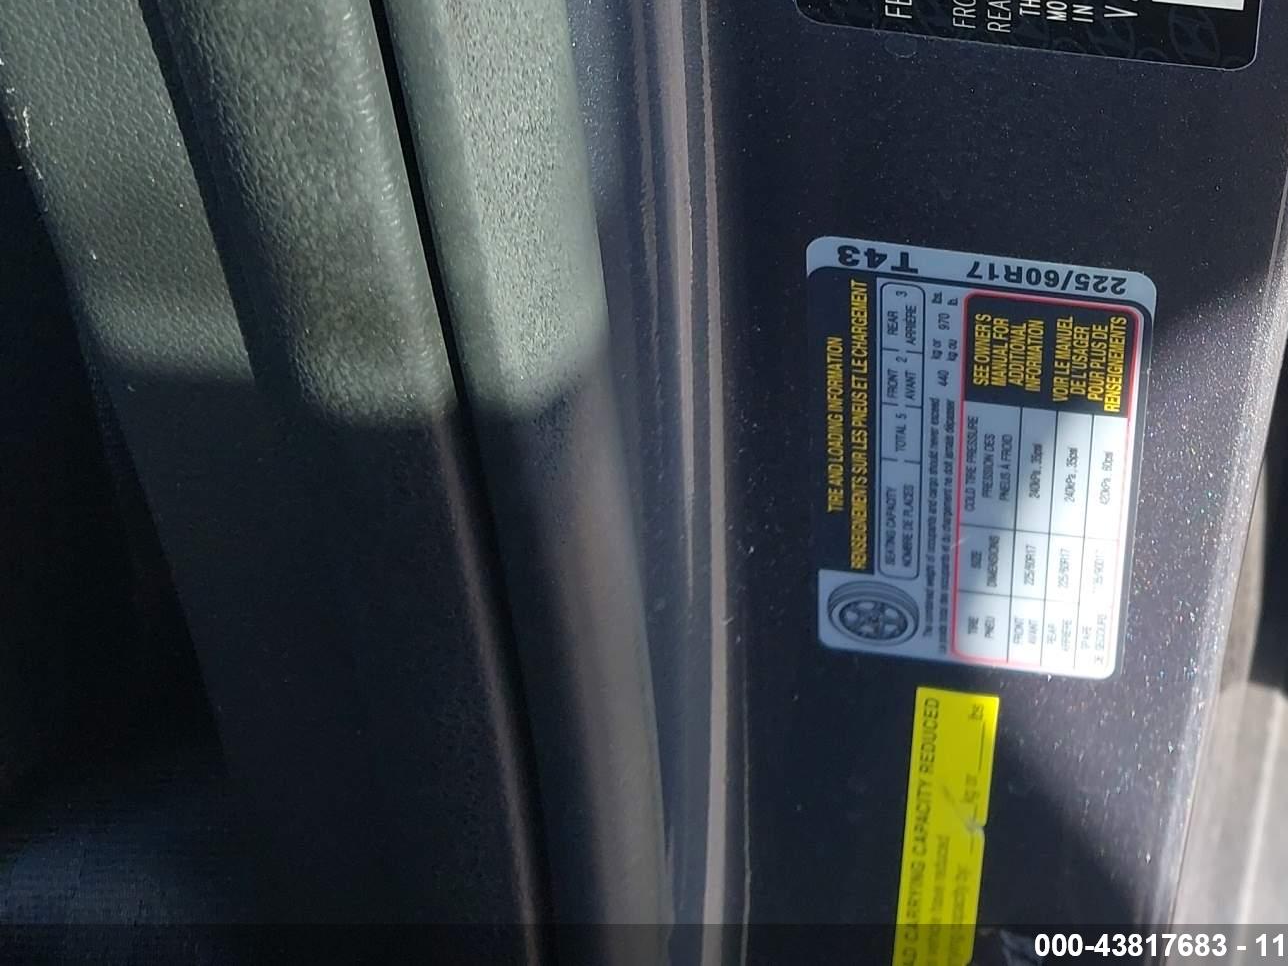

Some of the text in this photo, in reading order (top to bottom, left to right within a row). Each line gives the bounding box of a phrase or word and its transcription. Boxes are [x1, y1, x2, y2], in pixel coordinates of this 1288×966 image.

[1071, 3, 1093, 22] IN
[894, 288, 908, 298] 3
[966, 258, 1128, 299] 225/60R17
[849, 278, 869, 358] CHARGEMENT
[886, 309, 899, 336] REAR
[937, 311, 951, 331] 970
[850, 357, 868, 374] LE
[894, 354, 908, 363] 2
[989, 315, 1009, 387] MANUAL FOR
[1006, 320, 1027, 386] ADDITIONAL
[1024, 317, 1045, 392] INFORMATION
[1051, 313, 1075, 403] VOIR LE MANUEL
[1086, 322, 1110, 402] POUR PLUS DE
[1102, 314, 1129, 413] RENSEIGNEMENTS
[850, 372, 868, 390] ET
[886, 367, 899, 399] FRONT
[904, 369, 917, 401] AVANT
[936, 368, 949, 387] 440
[971, 363, 989, 386] SEE
[1069, 378, 1087, 395] DE
[824, 334, 846, 513] TIRE AND LOADING INFORMATION
[850, 389, 869, 428] PNEUS
[850, 427, 868, 450] LES
[894, 411, 907, 452] TOTAL 5
[849, 450, 868, 475] SUR
[917, 695, 941, 775] REDUCED
[910, 778, 934, 857] CAPACITY
[902, 860, 926, 942] CARRYING
